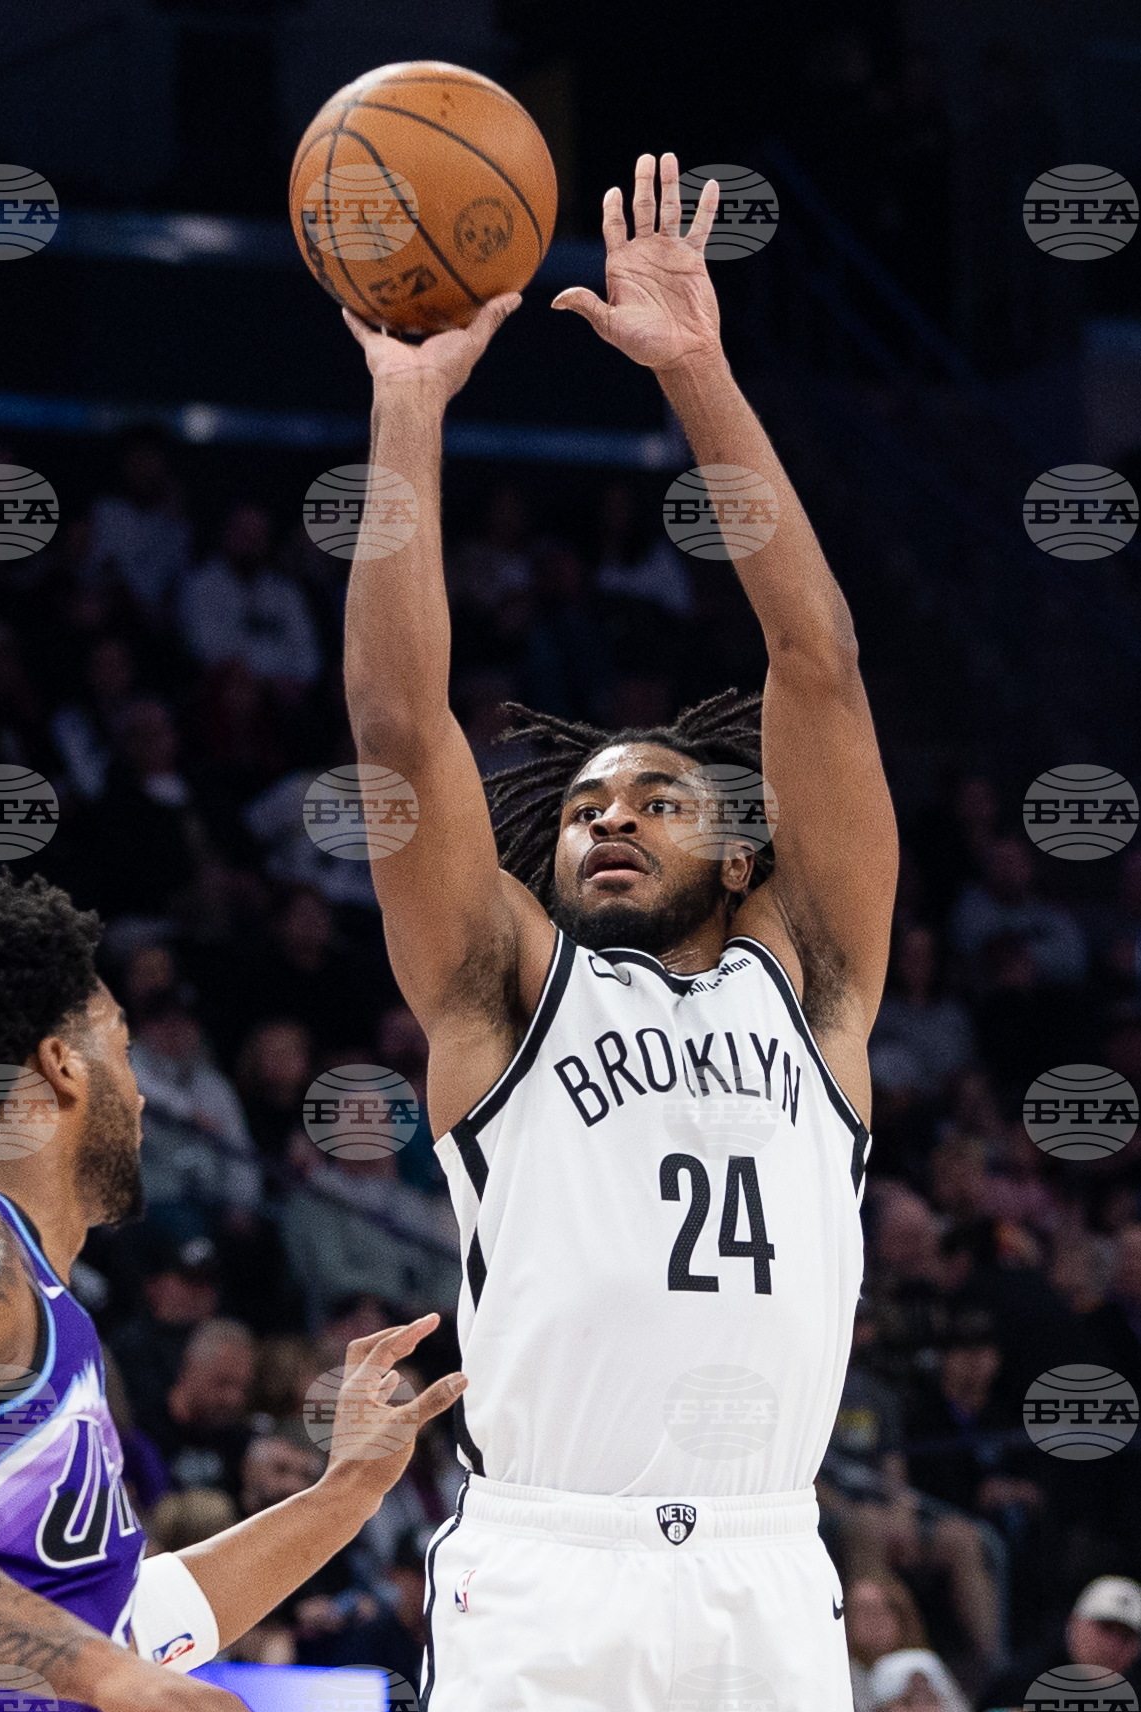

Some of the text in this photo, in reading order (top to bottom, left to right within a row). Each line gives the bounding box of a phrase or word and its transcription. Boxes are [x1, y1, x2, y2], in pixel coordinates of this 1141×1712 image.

[718, 958, 751, 976] Won
[553, 1027, 801, 1128] BROKLYN
[659, 1152, 775, 1295] 24
[659, 1504, 695, 1524] NETS
